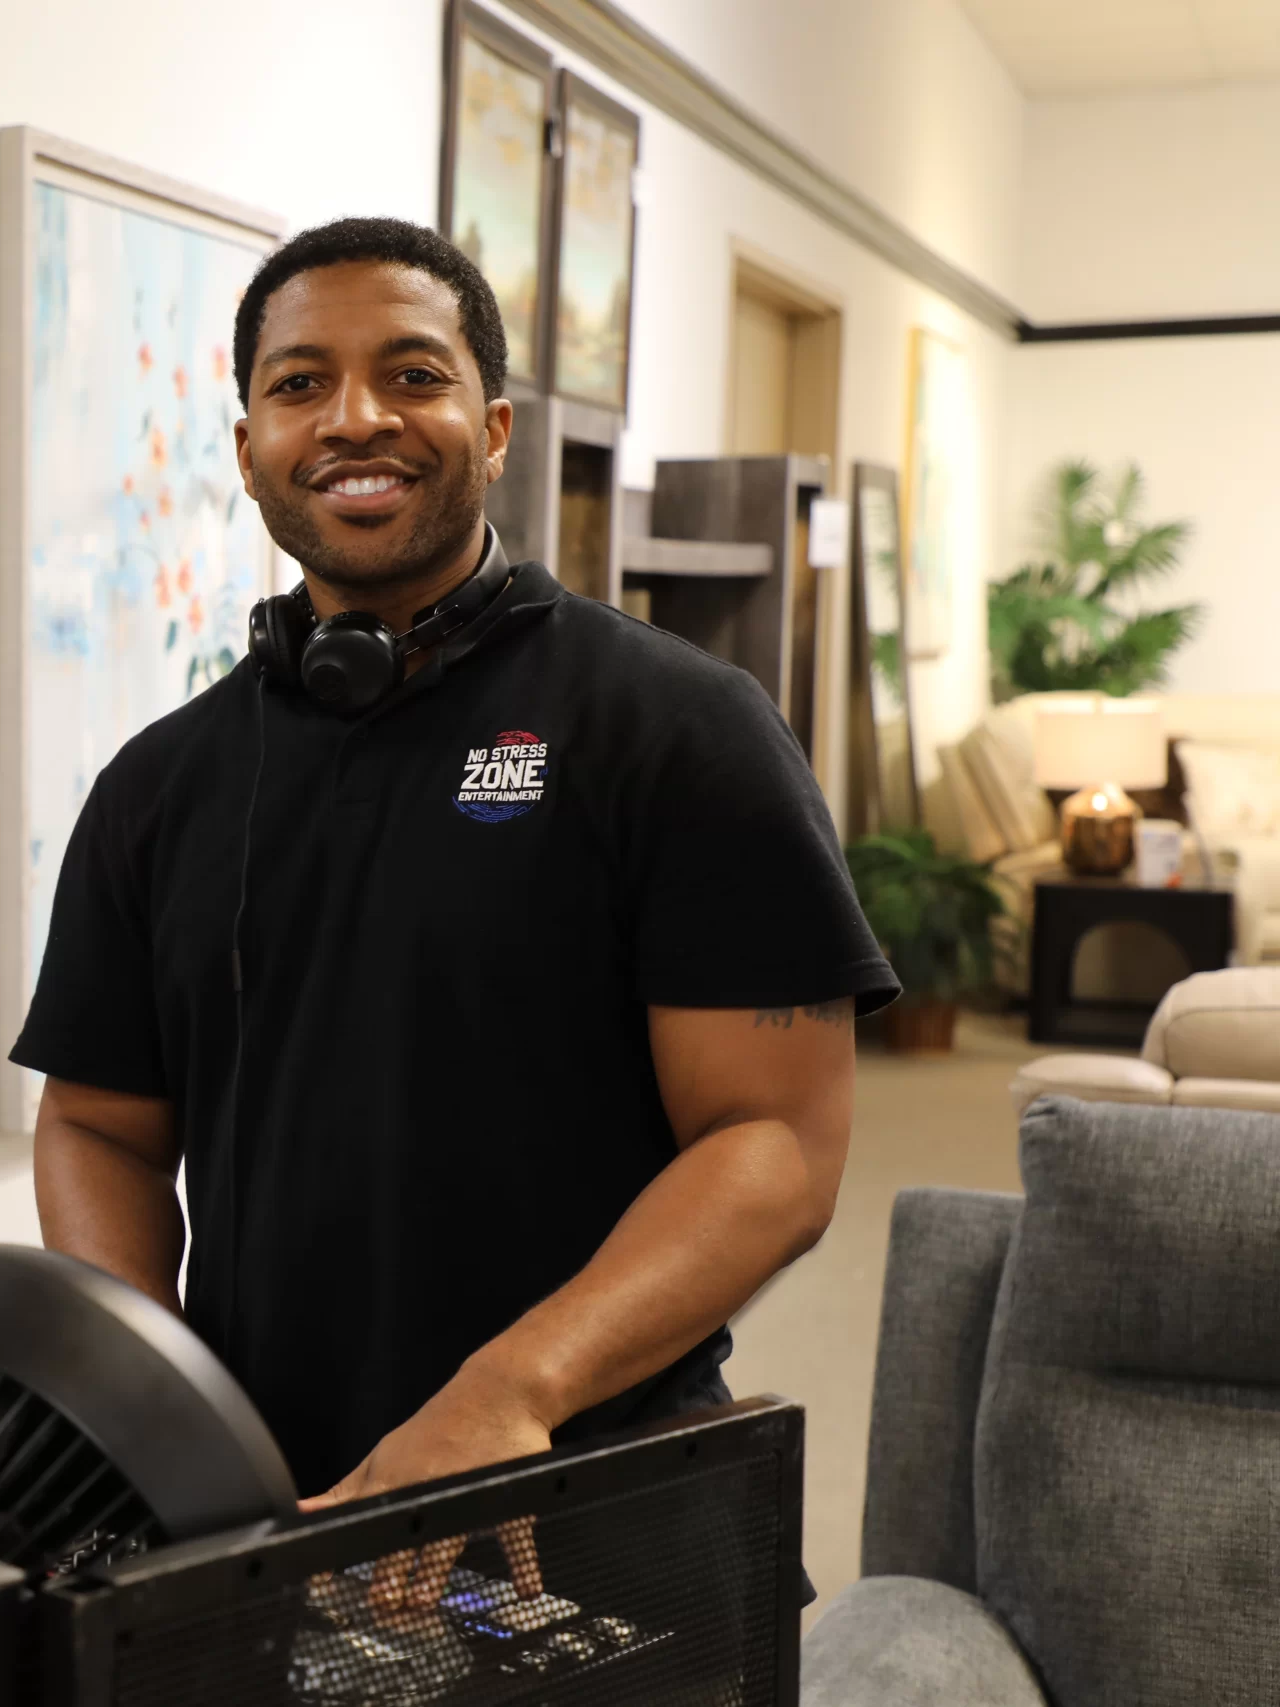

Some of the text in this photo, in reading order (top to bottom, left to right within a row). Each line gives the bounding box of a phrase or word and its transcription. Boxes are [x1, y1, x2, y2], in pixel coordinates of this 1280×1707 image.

[467, 743, 548, 763] NO STRESS
[461, 759, 546, 790] ZONE
[458, 790, 544, 802] ENTERTAINMENT
